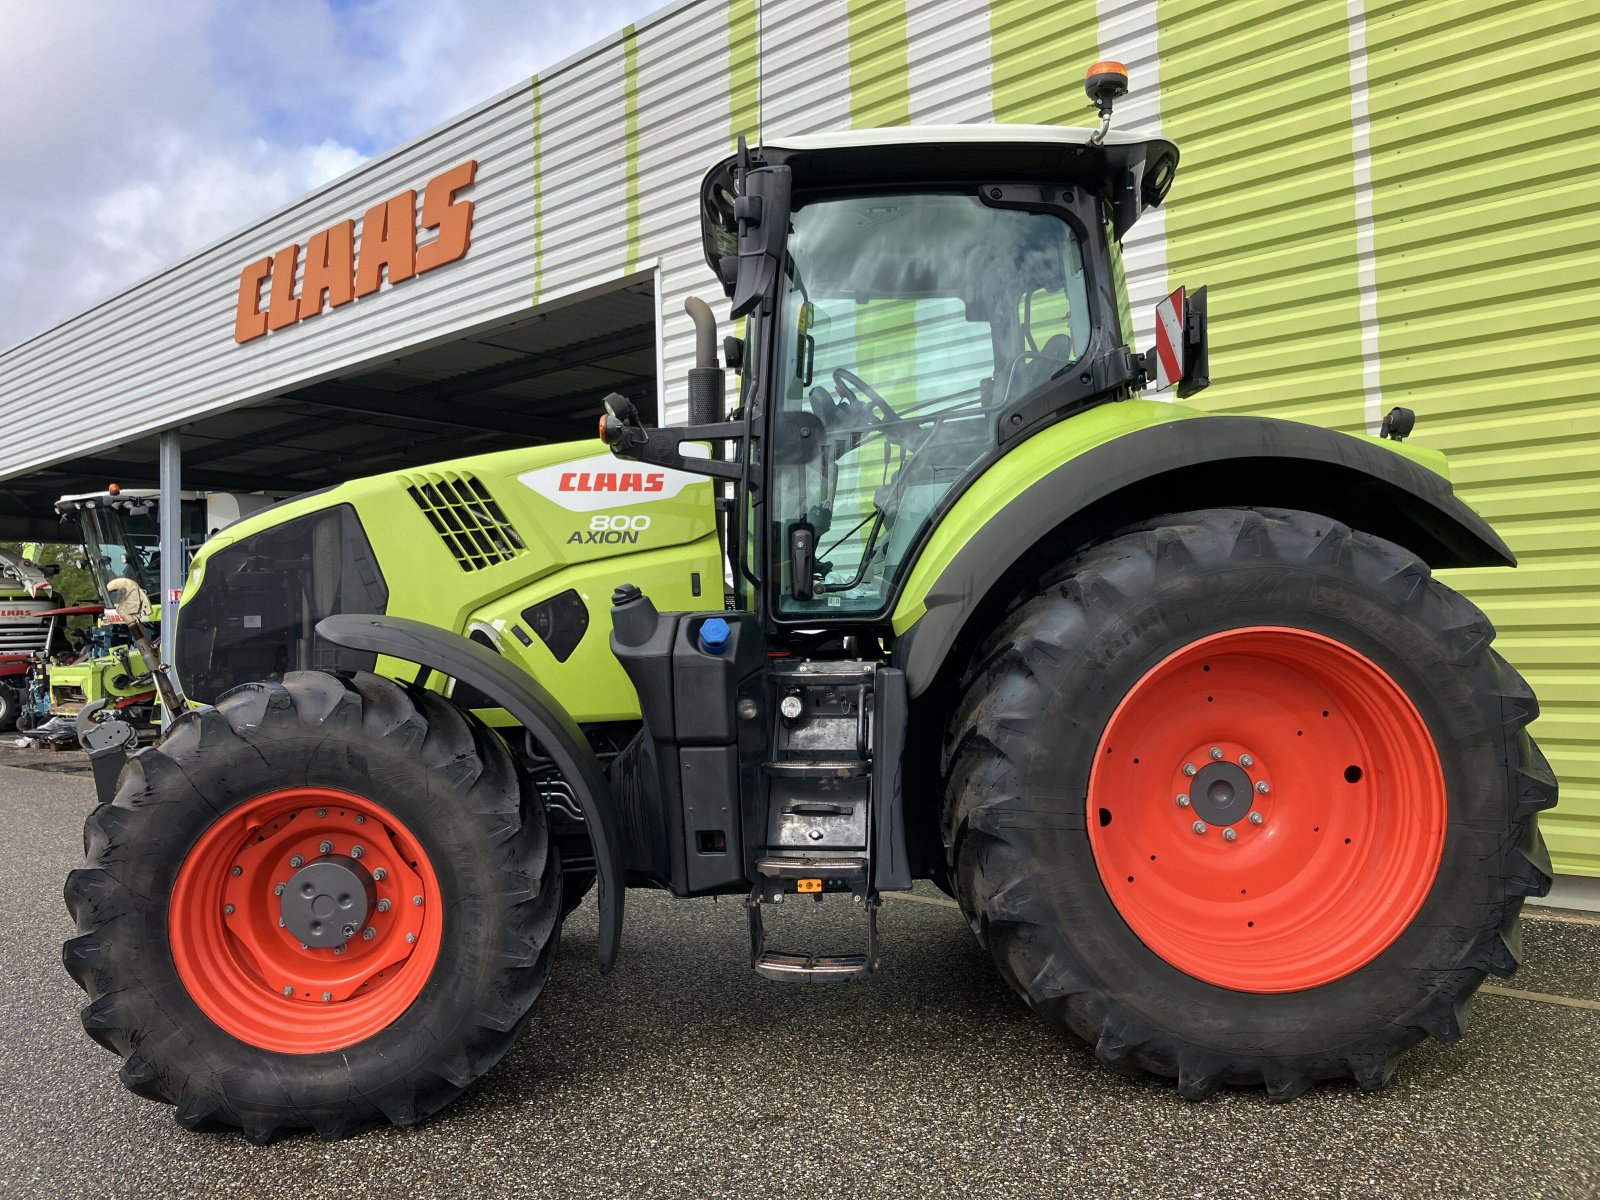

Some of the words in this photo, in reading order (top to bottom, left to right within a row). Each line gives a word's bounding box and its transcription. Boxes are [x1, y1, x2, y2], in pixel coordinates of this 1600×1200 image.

[234, 159, 477, 344] CLAAS
[558, 472, 665, 492] CLAAS
[589, 514, 652, 531] 800
[566, 530, 640, 545] AXION
[0, 609, 32, 617] LAAS
